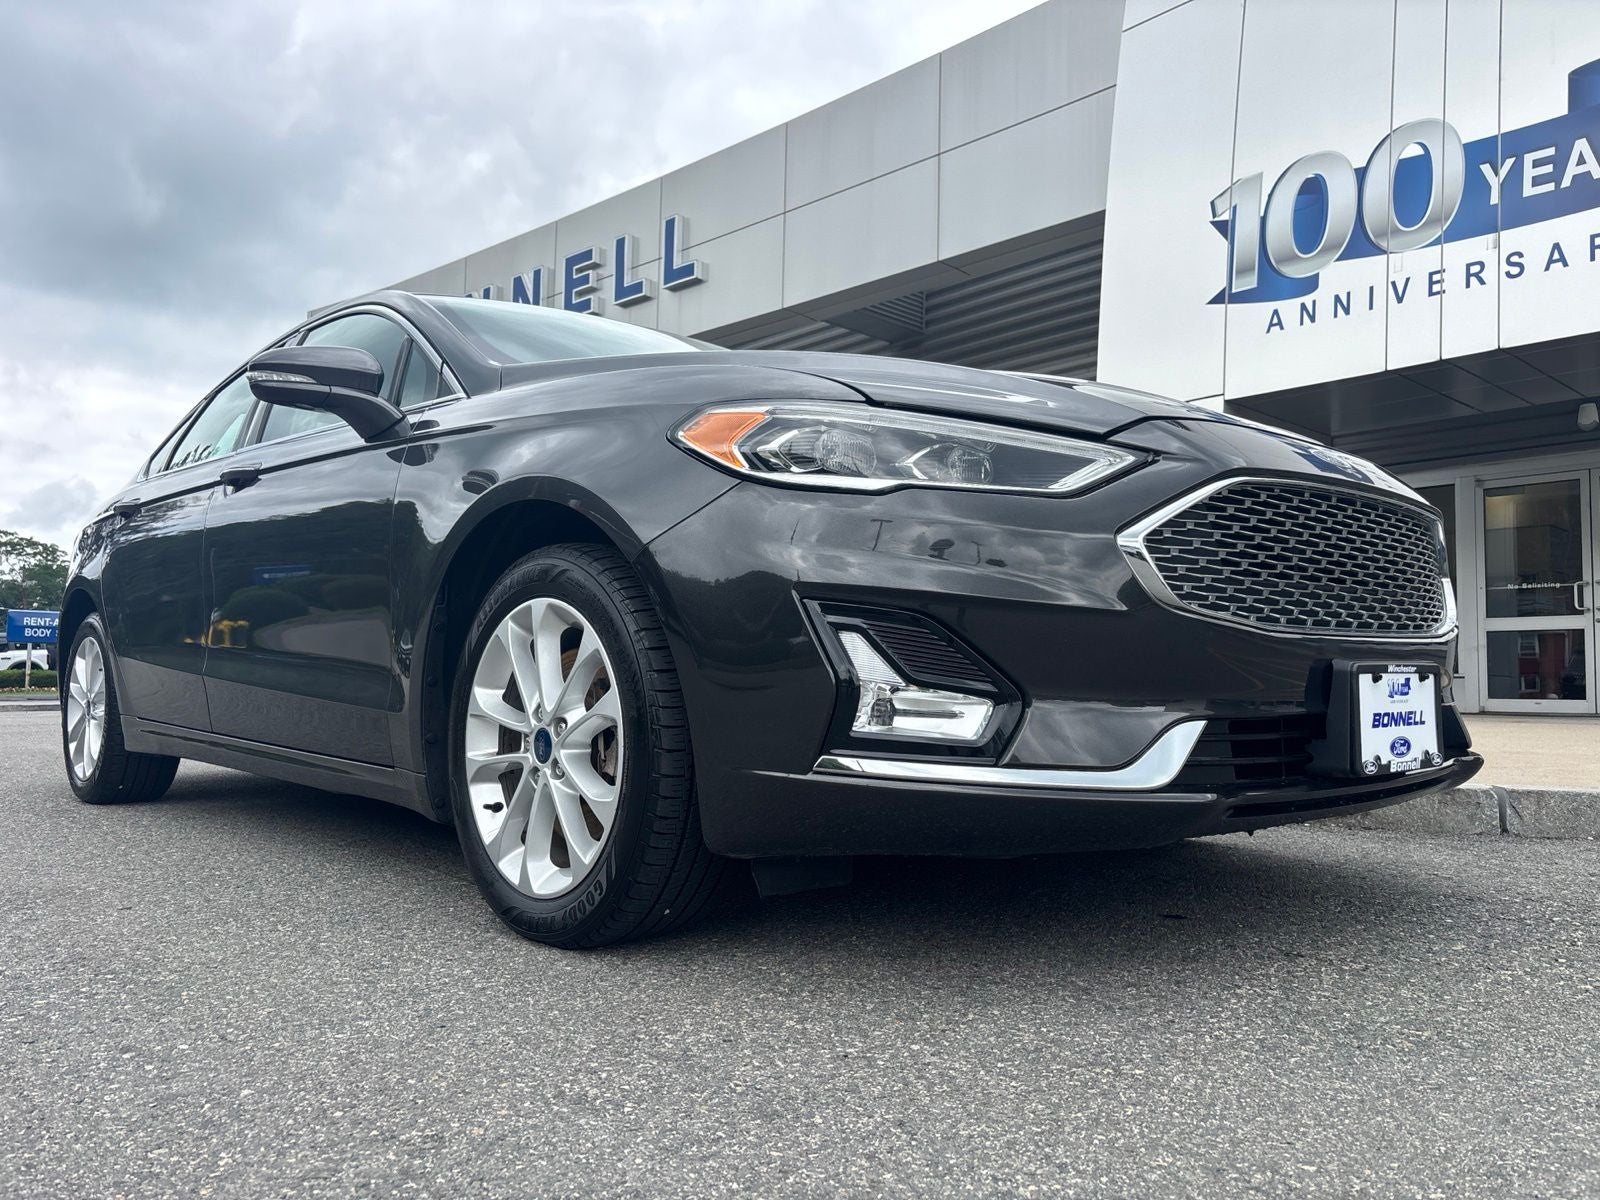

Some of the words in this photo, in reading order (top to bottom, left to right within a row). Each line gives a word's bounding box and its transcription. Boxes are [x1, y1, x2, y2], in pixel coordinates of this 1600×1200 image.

[1210, 117, 1466, 294] 100
[1479, 137, 1600, 207] YEA
[465, 214, 702, 314] NELL
[24, 628, 52, 637] BODY
[1387, 664, 1417, 673] Winchester
[1371, 710, 1426, 729] BONNELL
[1390, 757, 1421, 773] Bonnell
